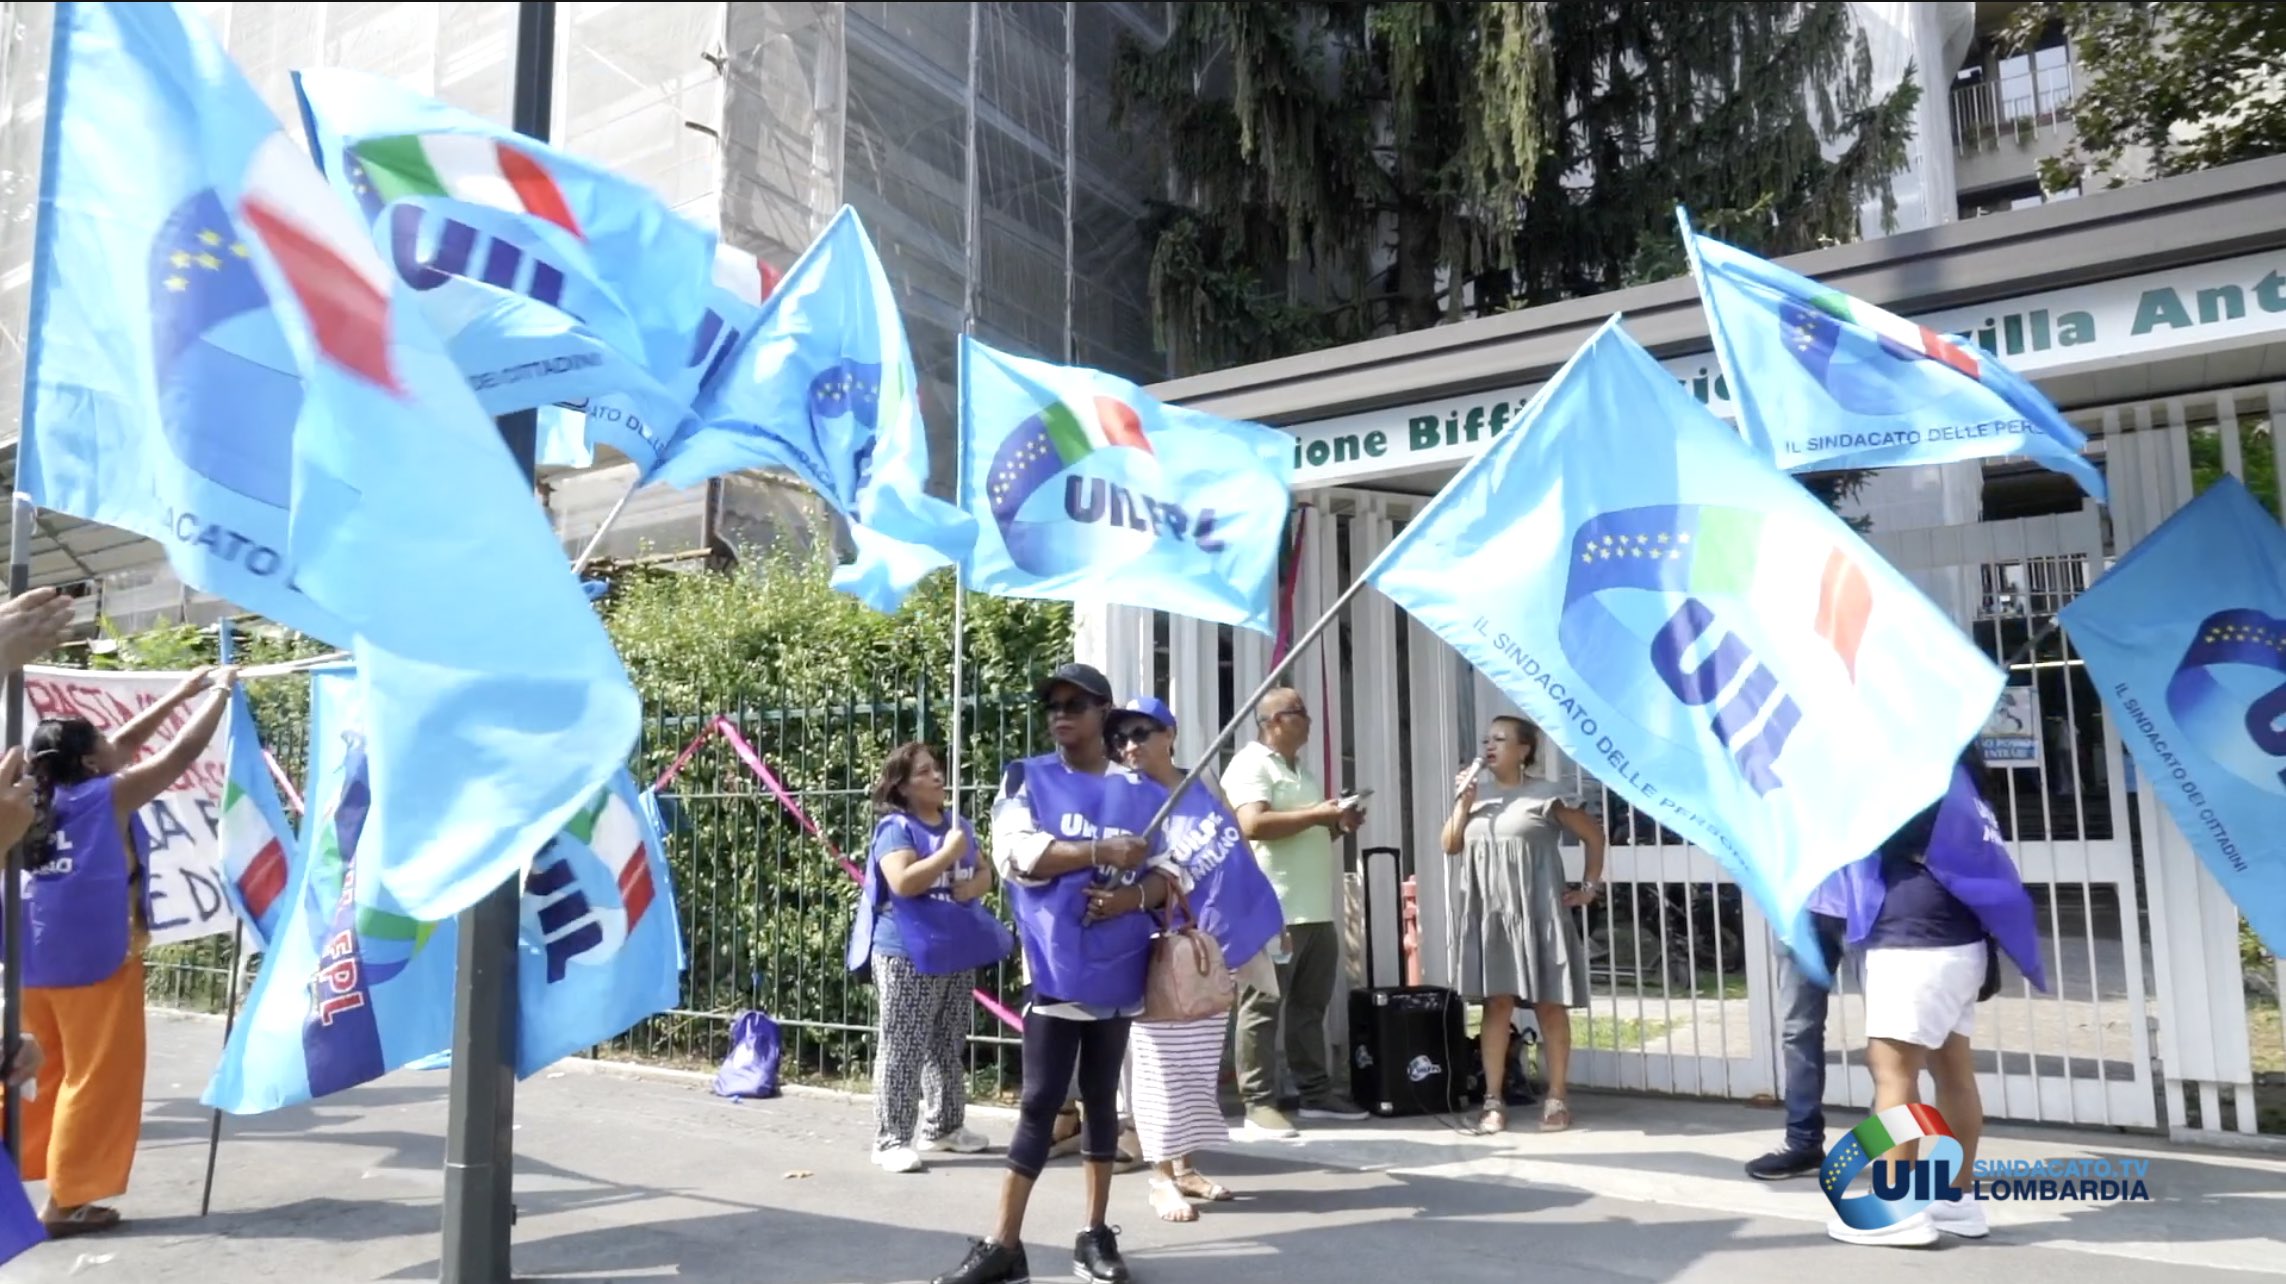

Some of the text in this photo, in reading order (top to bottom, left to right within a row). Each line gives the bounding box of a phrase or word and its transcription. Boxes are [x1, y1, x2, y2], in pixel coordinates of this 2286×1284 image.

[1960, 309, 2096, 358] illa
[1807, 430, 1921, 451] SINDACATO
[1928, 424, 1991, 443] DELLE
[1493, 632, 1598, 737] SINDACATO
[1595, 735, 1658, 798] DELLE
[1651, 597, 1803, 800] UIL
[2115, 682, 2248, 873] IL SINDACATO DEI CITTADINI
